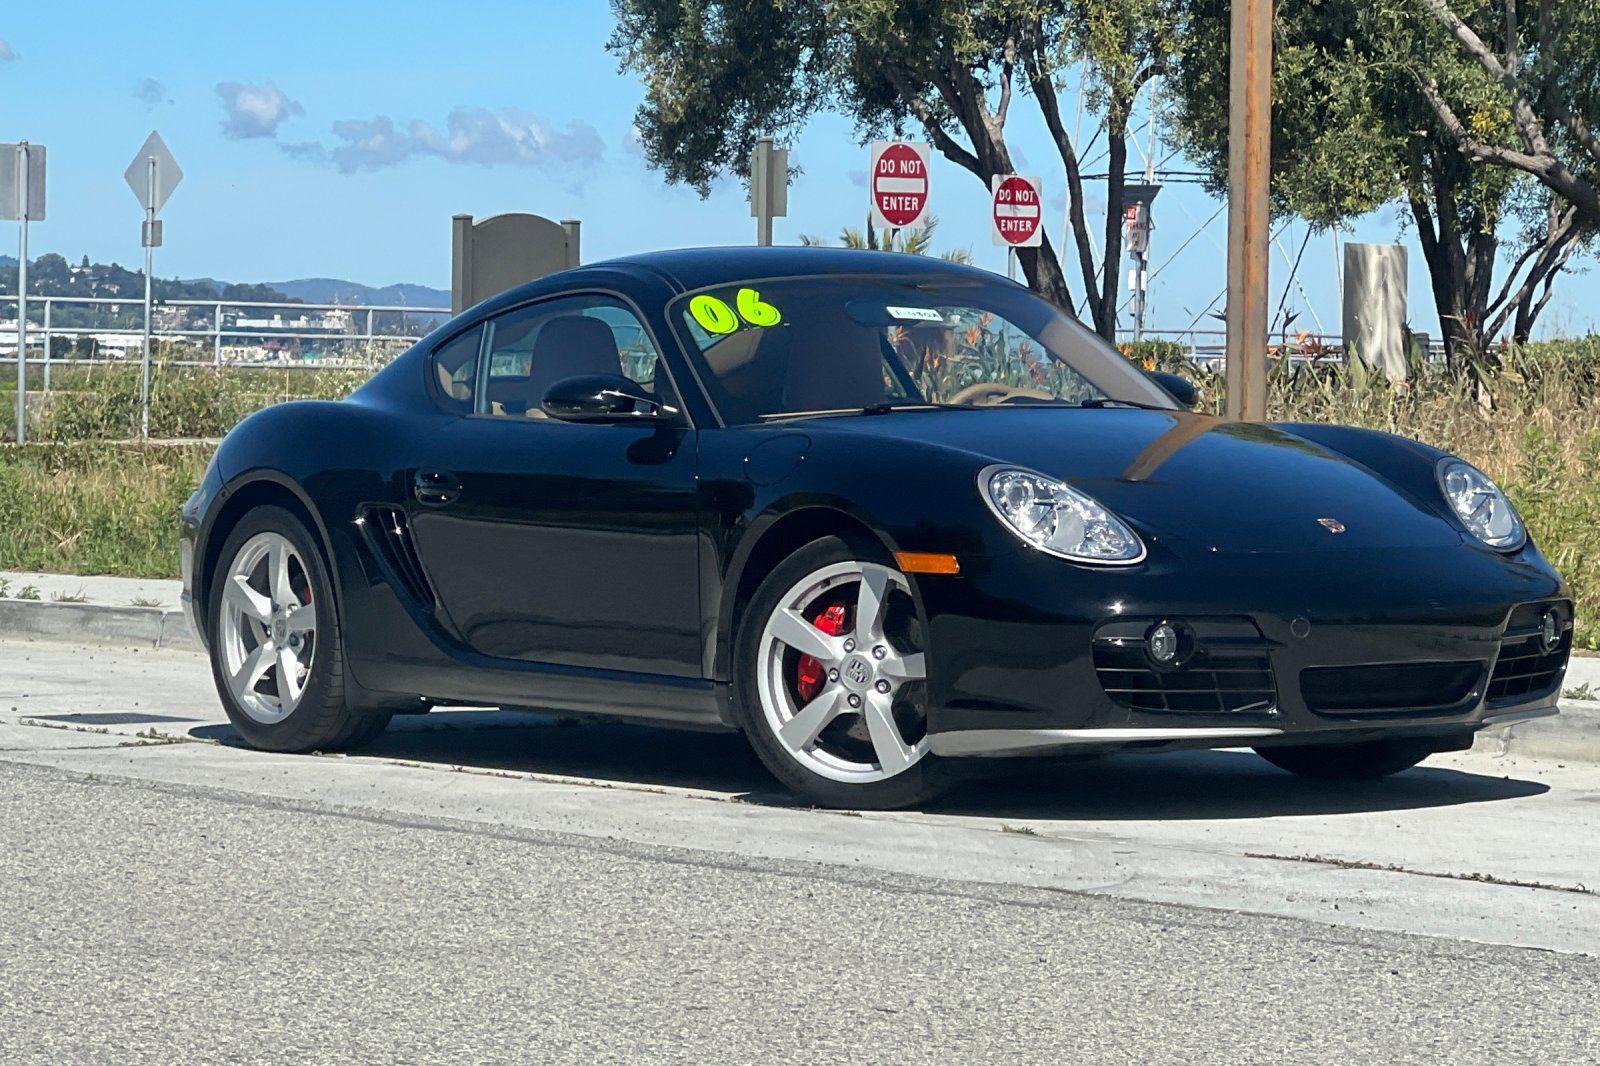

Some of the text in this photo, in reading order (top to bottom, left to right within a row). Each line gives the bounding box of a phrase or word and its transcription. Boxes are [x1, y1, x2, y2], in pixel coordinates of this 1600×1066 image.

[880, 159, 921, 174] DO NOT
[999, 189, 1035, 202] DO NOT
[882, 196, 919, 211] ENTER
[1000, 219, 1032, 232] ENTER
[689, 288, 782, 335] 06
